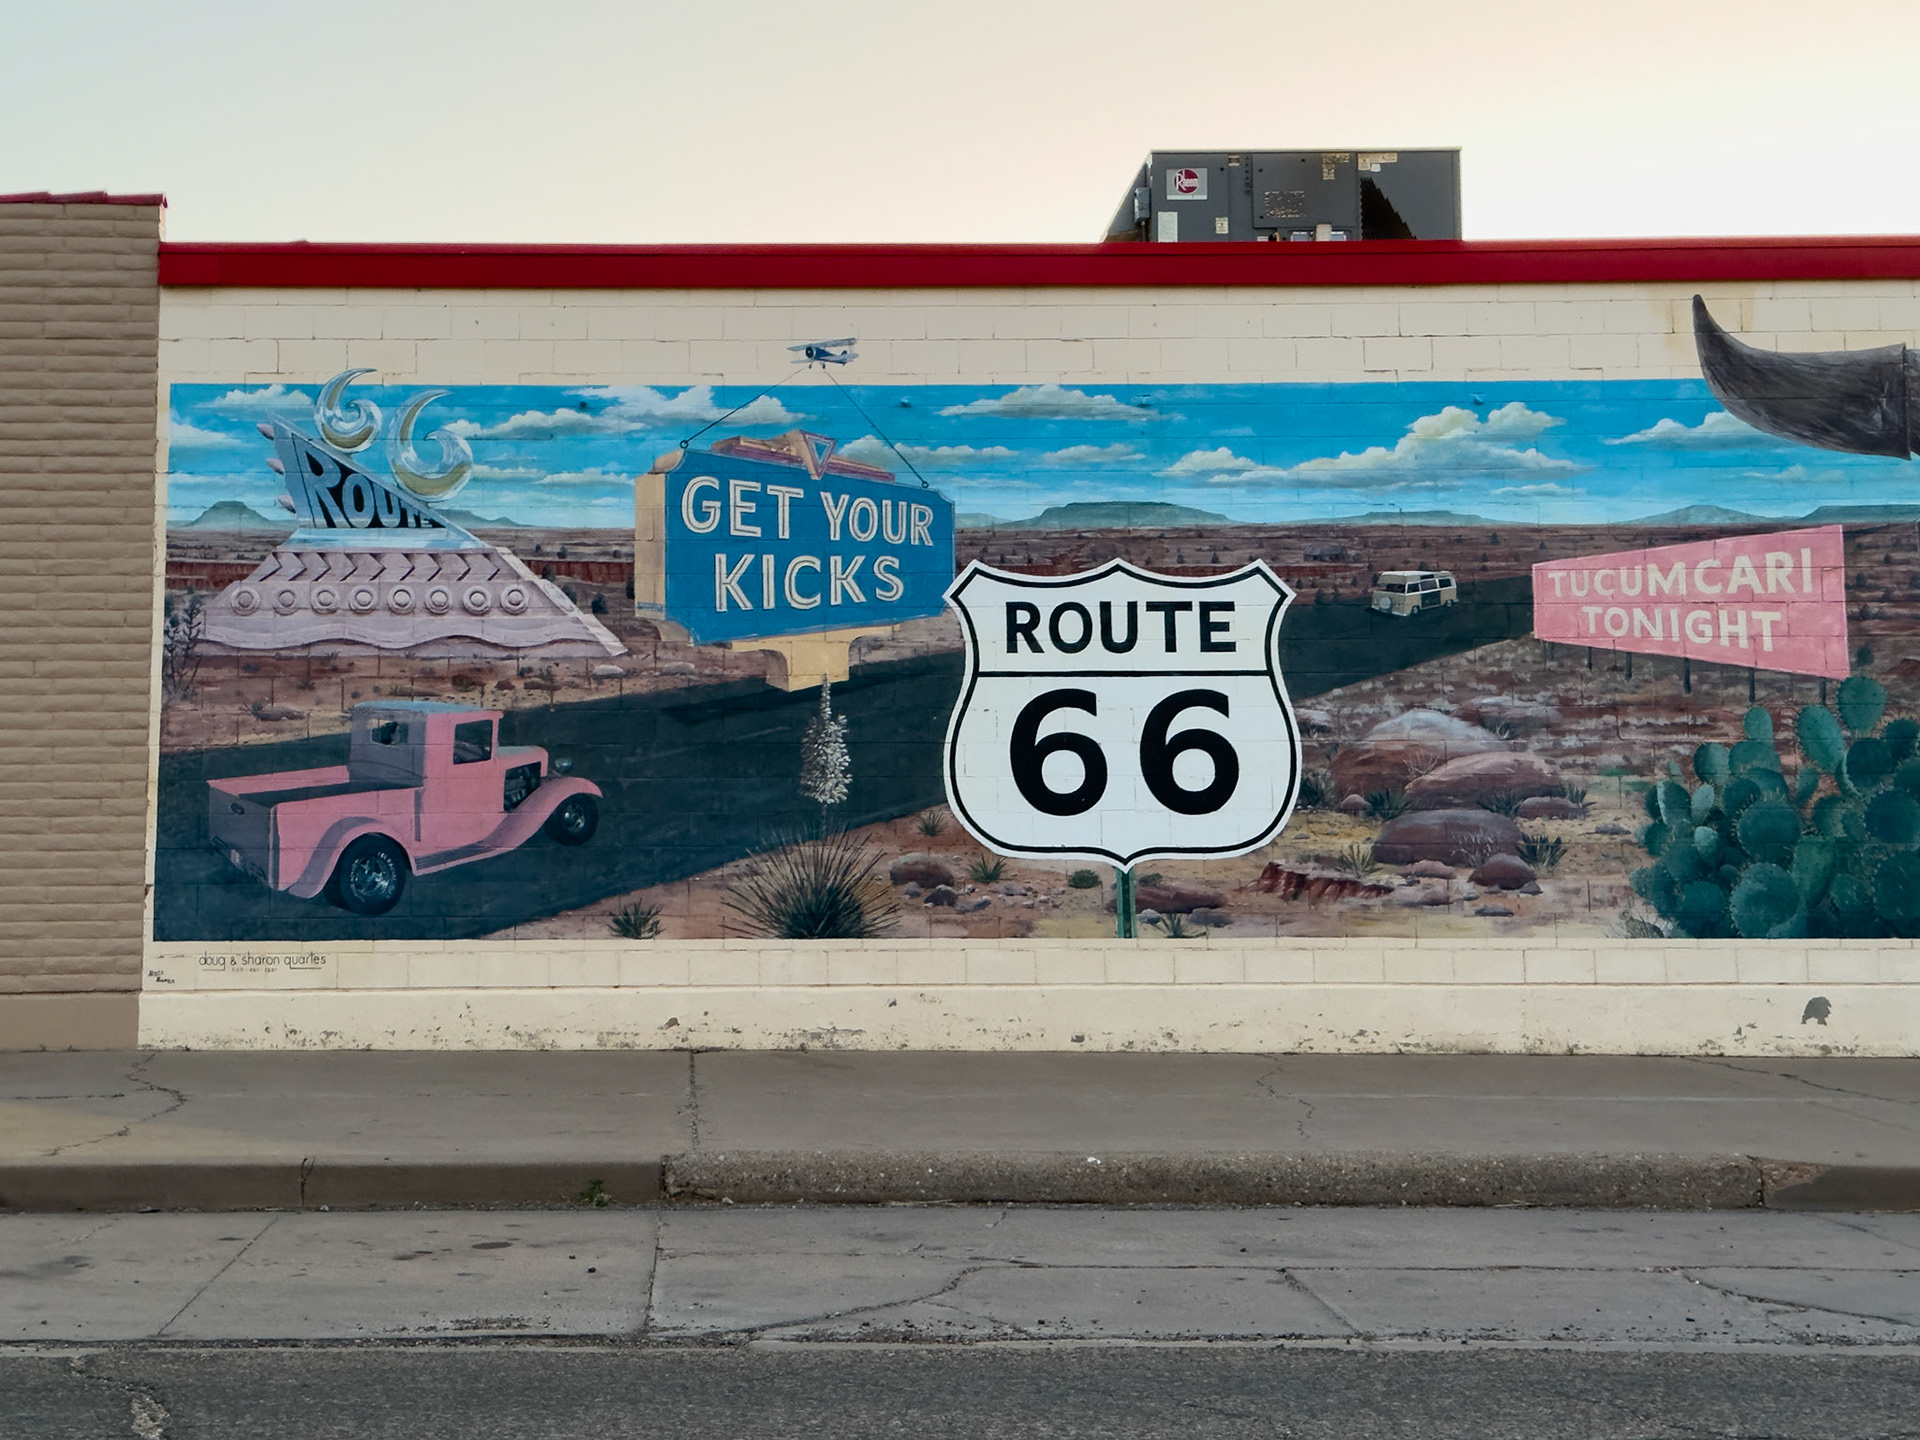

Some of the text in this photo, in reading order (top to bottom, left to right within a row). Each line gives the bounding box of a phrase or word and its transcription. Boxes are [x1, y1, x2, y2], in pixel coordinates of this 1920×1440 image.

[293, 432, 438, 528] ROUTE
[681, 475, 934, 546] GET YOUR
[715, 553, 904, 612] KICKS
[1548, 548, 1813, 597] TUCUMCARI
[1006, 601, 1236, 654] ROUTE
[1582, 606, 1782, 651] TONIGHT
[1010, 688, 1239, 816] 66
[199, 951, 226, 971] doug
[230, 956, 237, 966] &
[241, 951, 280, 966] sharon
